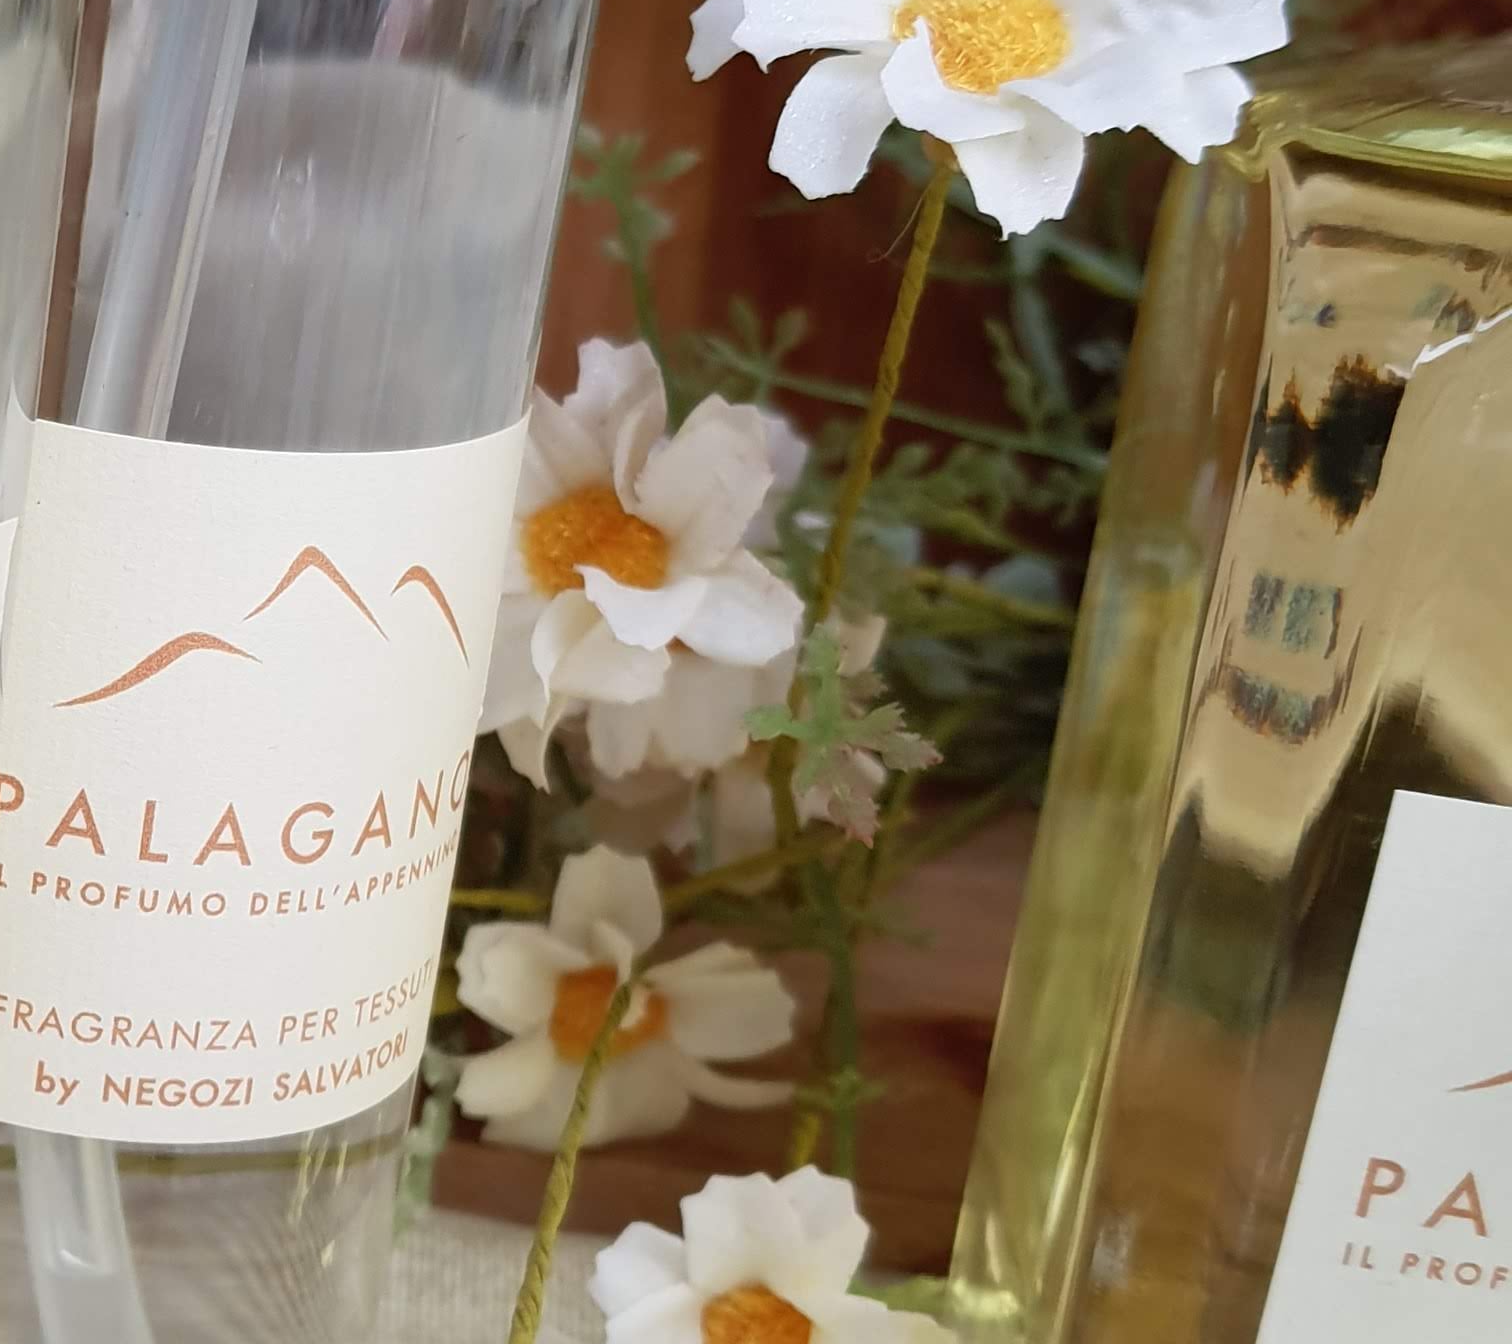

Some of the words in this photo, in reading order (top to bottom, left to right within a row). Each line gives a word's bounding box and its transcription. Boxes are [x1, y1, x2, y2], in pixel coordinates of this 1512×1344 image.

[31, 872, 226, 916] PROFUMO
[279, 1008, 338, 1046] PER
[35, 1060, 80, 1105] by
[103, 1074, 253, 1107] NEGOZI
[273, 1028, 408, 1101] SALVATORI
[1342, 1243, 1374, 1270] IL
